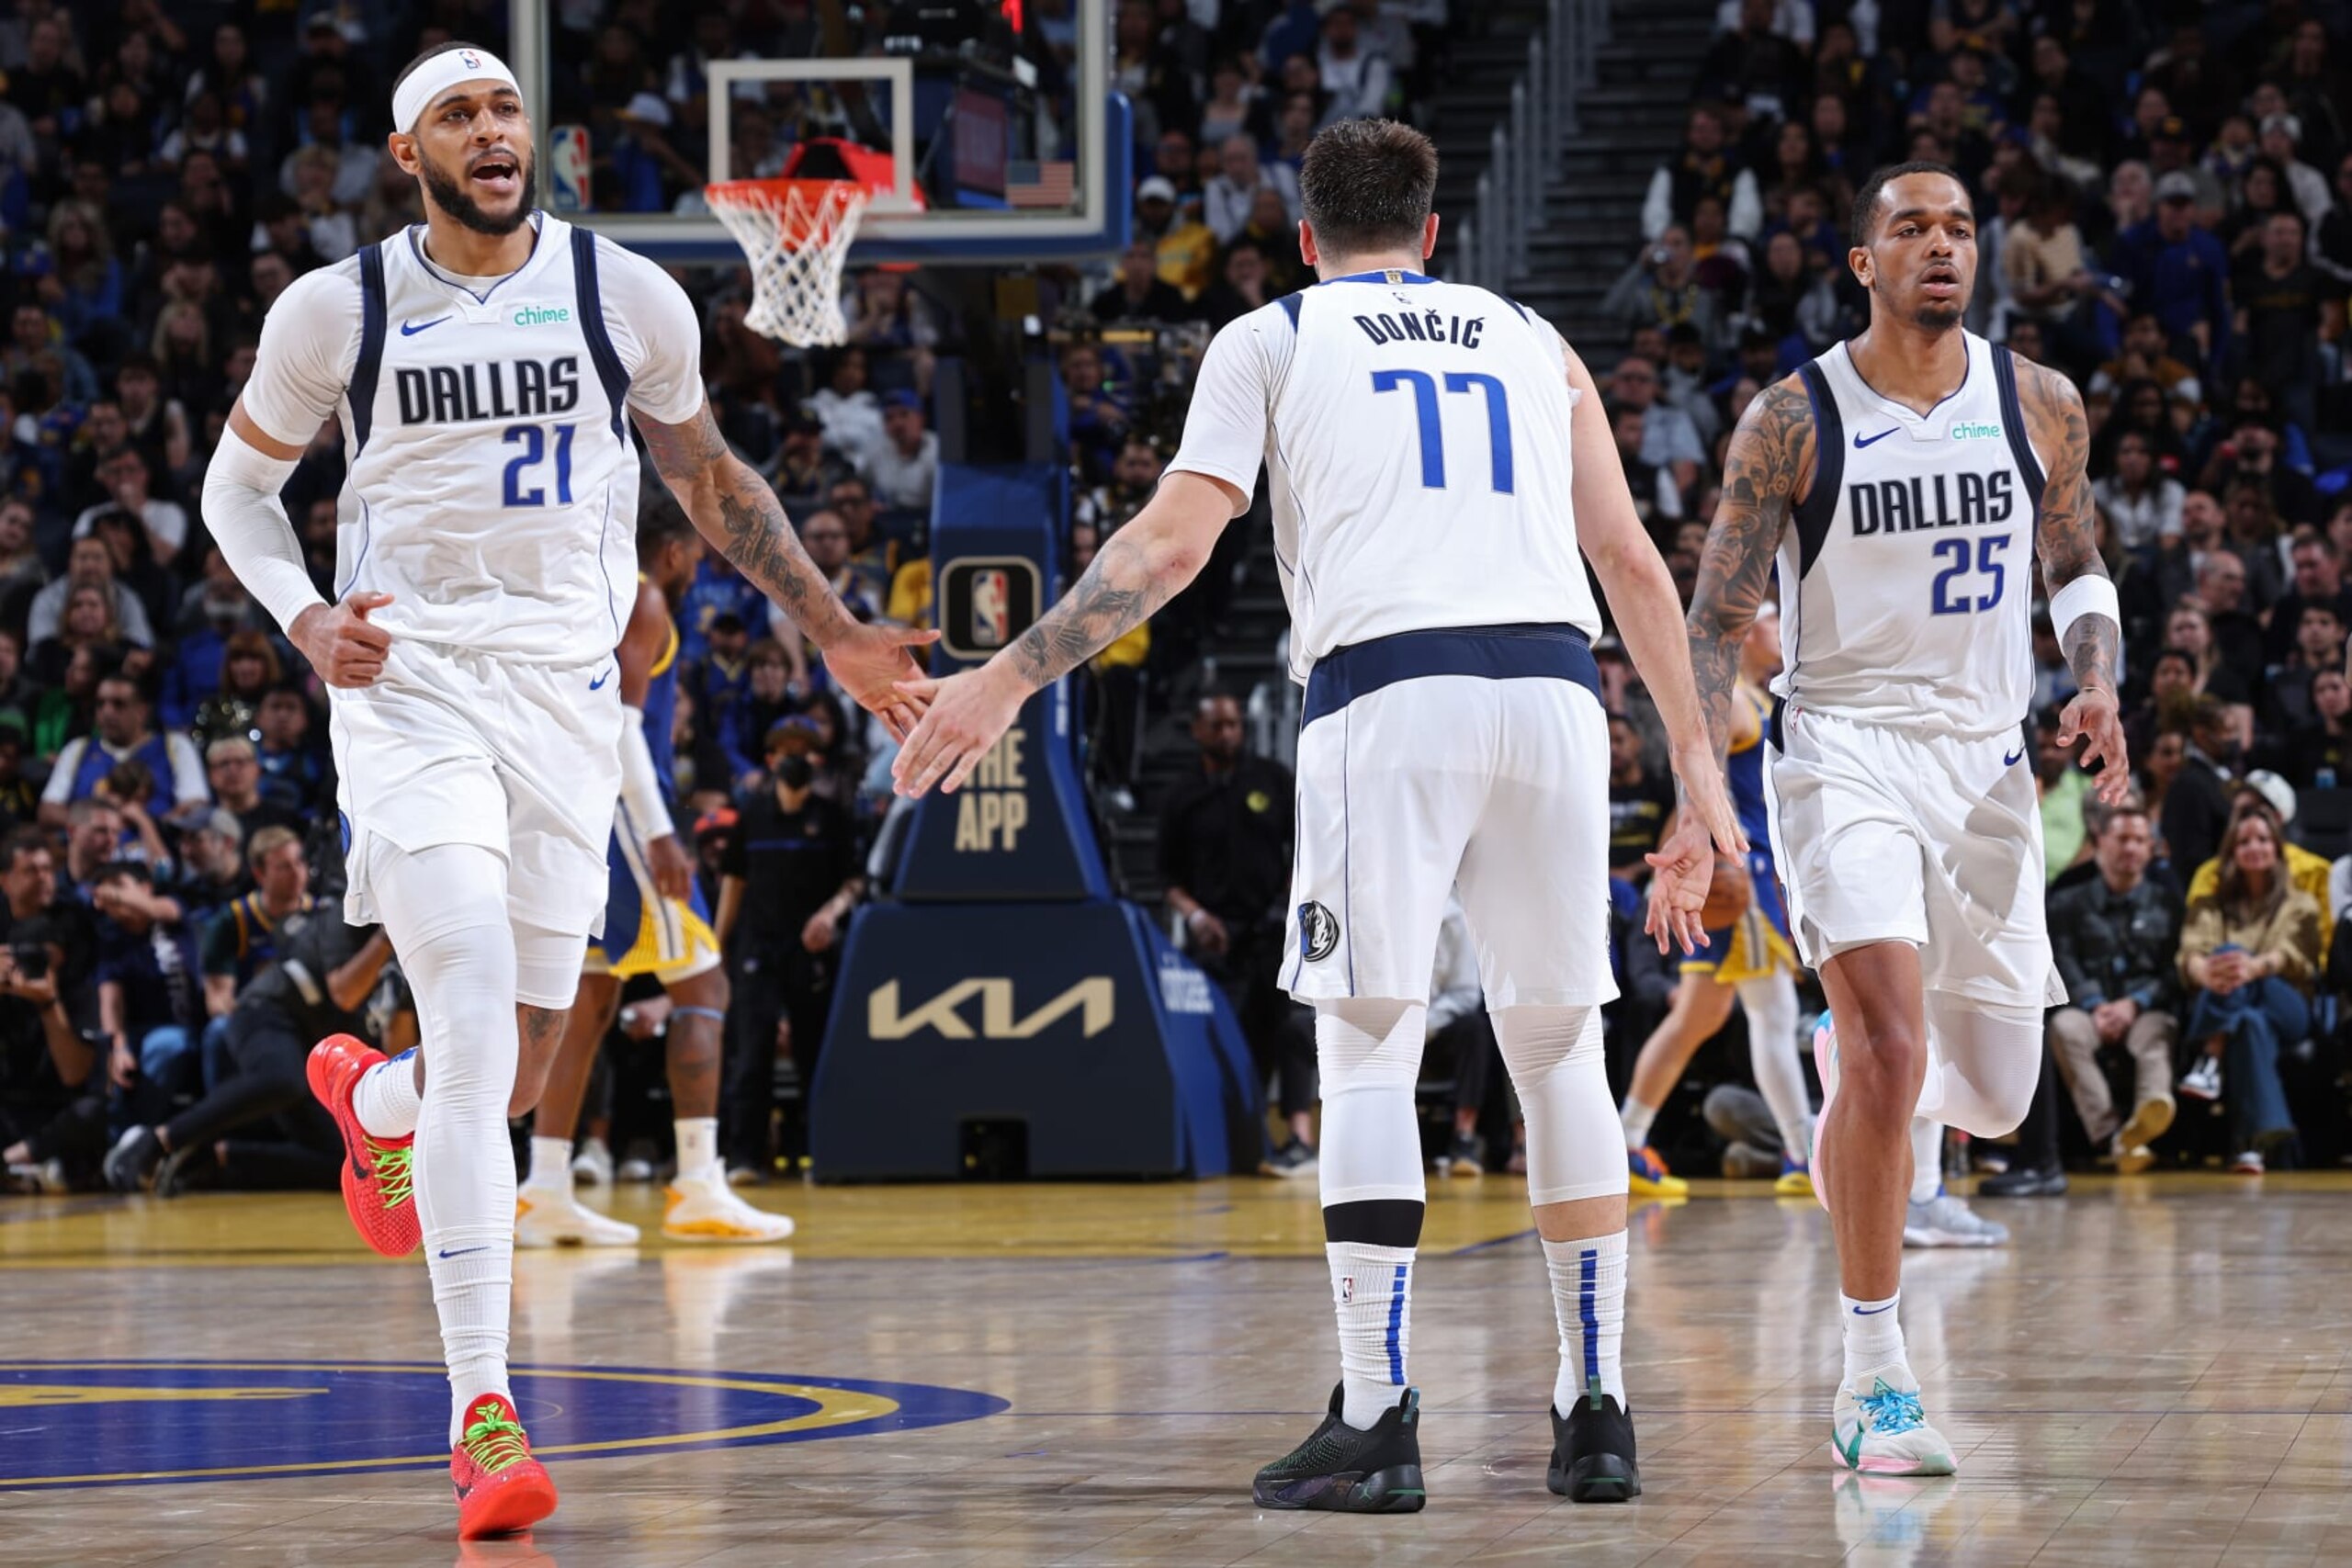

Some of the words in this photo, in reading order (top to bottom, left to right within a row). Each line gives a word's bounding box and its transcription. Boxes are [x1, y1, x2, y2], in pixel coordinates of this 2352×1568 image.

[514, 306, 570, 325] chime
[1352, 308, 1486, 350] DONČIĆ
[395, 355, 579, 425] DALLAS
[1370, 368, 1514, 496] 77
[1951, 422, 2001, 440] chime
[502, 423, 577, 508] 21
[1849, 468, 2014, 537] DALLAS
[1930, 533, 2012, 616] 25
[954, 791, 1028, 852] APP
[868, 976, 1114, 1040] KIA
